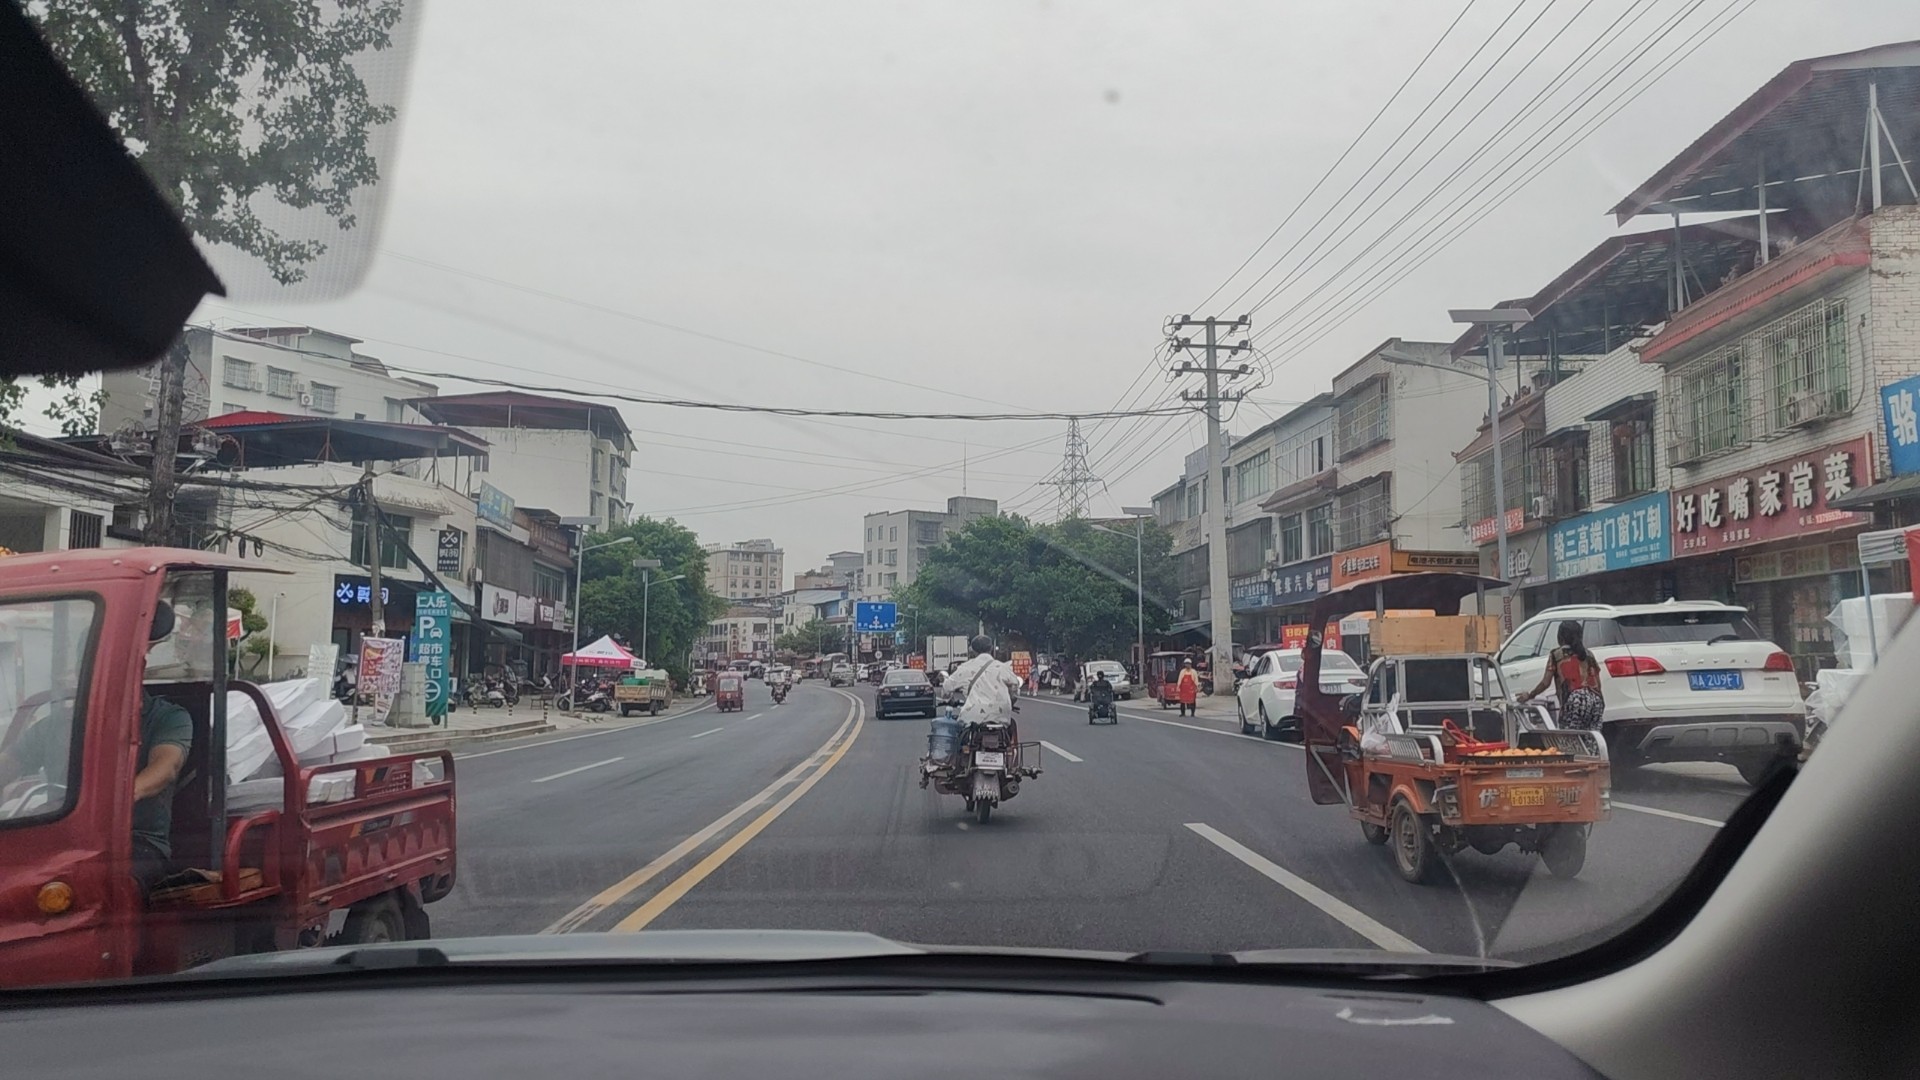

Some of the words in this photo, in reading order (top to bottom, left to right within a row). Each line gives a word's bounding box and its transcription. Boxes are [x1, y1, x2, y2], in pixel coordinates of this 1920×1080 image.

[1888, 388, 1920, 447] 骆
[1676, 451, 1851, 534] 好吃嘴家常菜
[1554, 504, 1661, 561] 骆三高端门窗订制
[416, 596, 447, 608] 仁人乐
[419, 616, 435, 639] P
[419, 644, 443, 654] 超市
